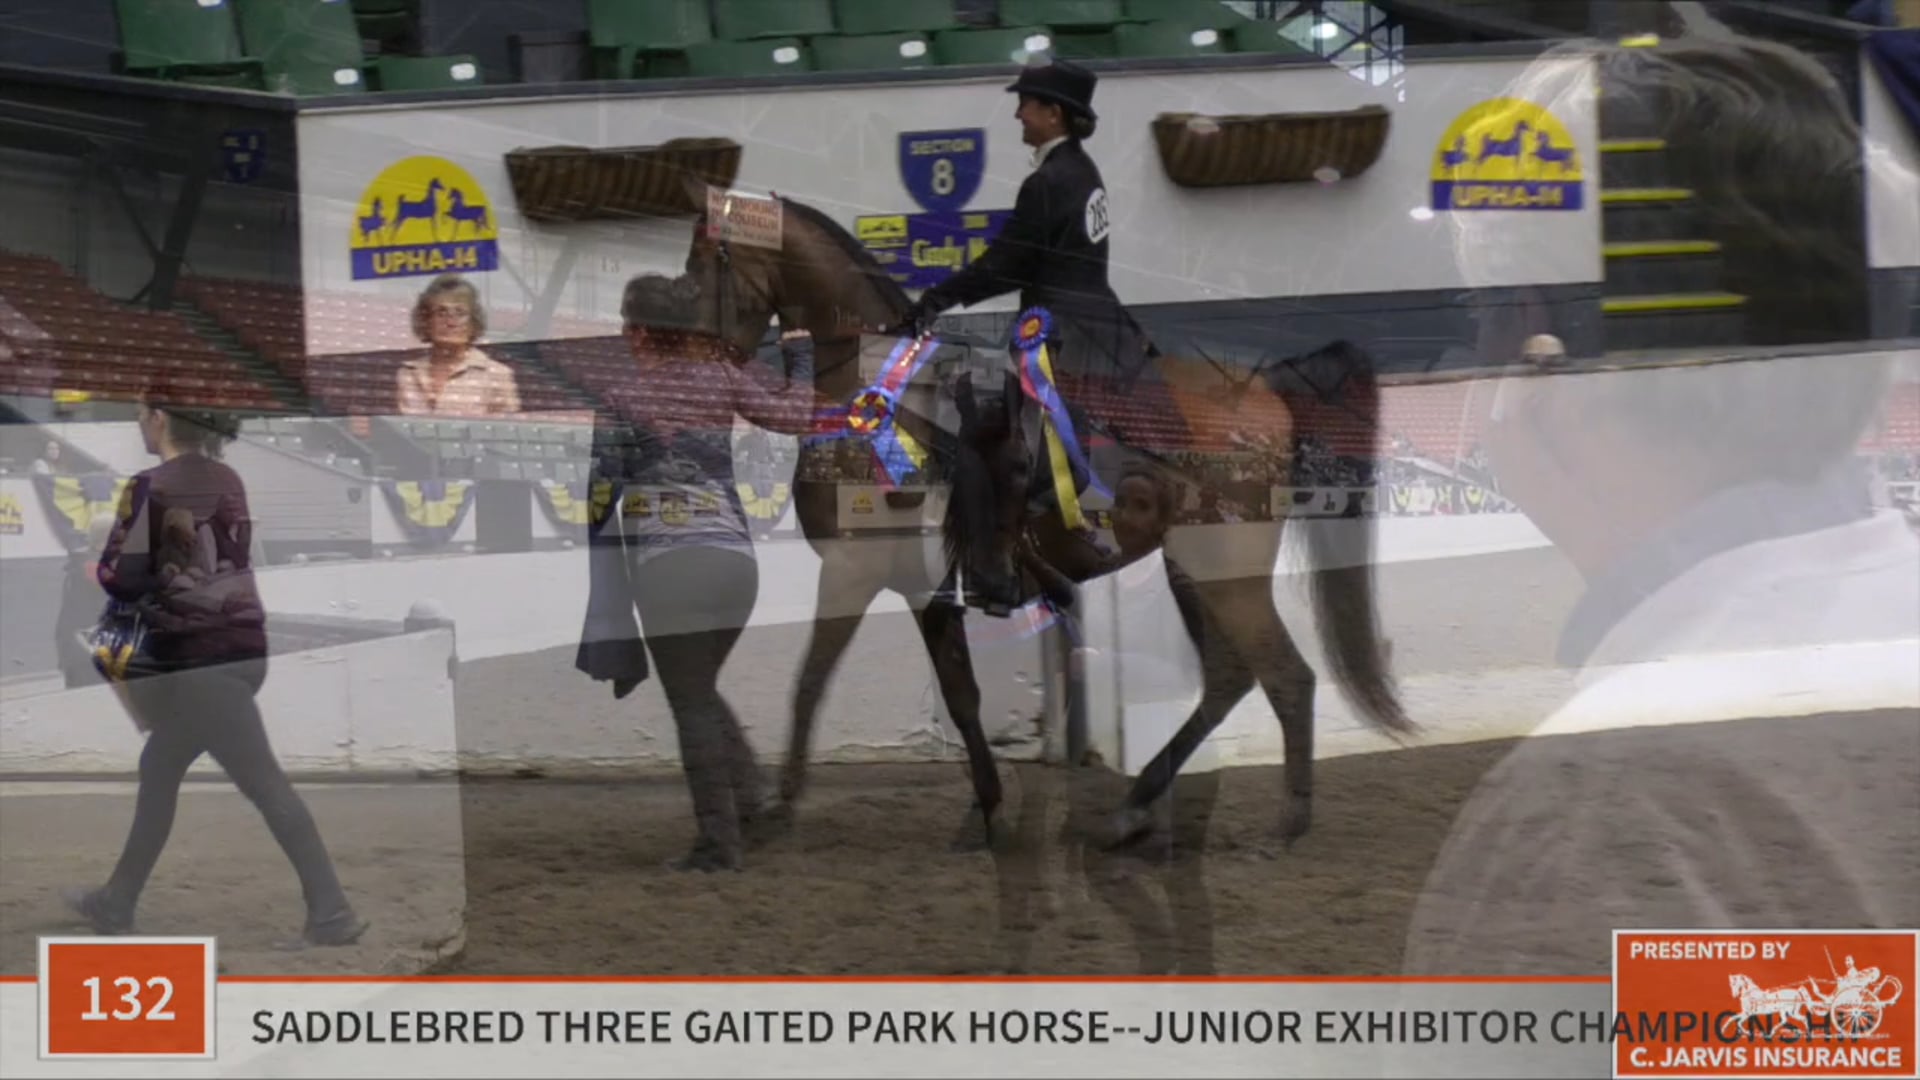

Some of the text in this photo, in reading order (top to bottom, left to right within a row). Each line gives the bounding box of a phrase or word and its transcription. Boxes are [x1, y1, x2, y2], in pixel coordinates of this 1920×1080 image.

[909, 138, 976, 156] SECTION
[931, 158, 955, 195] 8
[373, 247, 478, 274] UPHA-14
